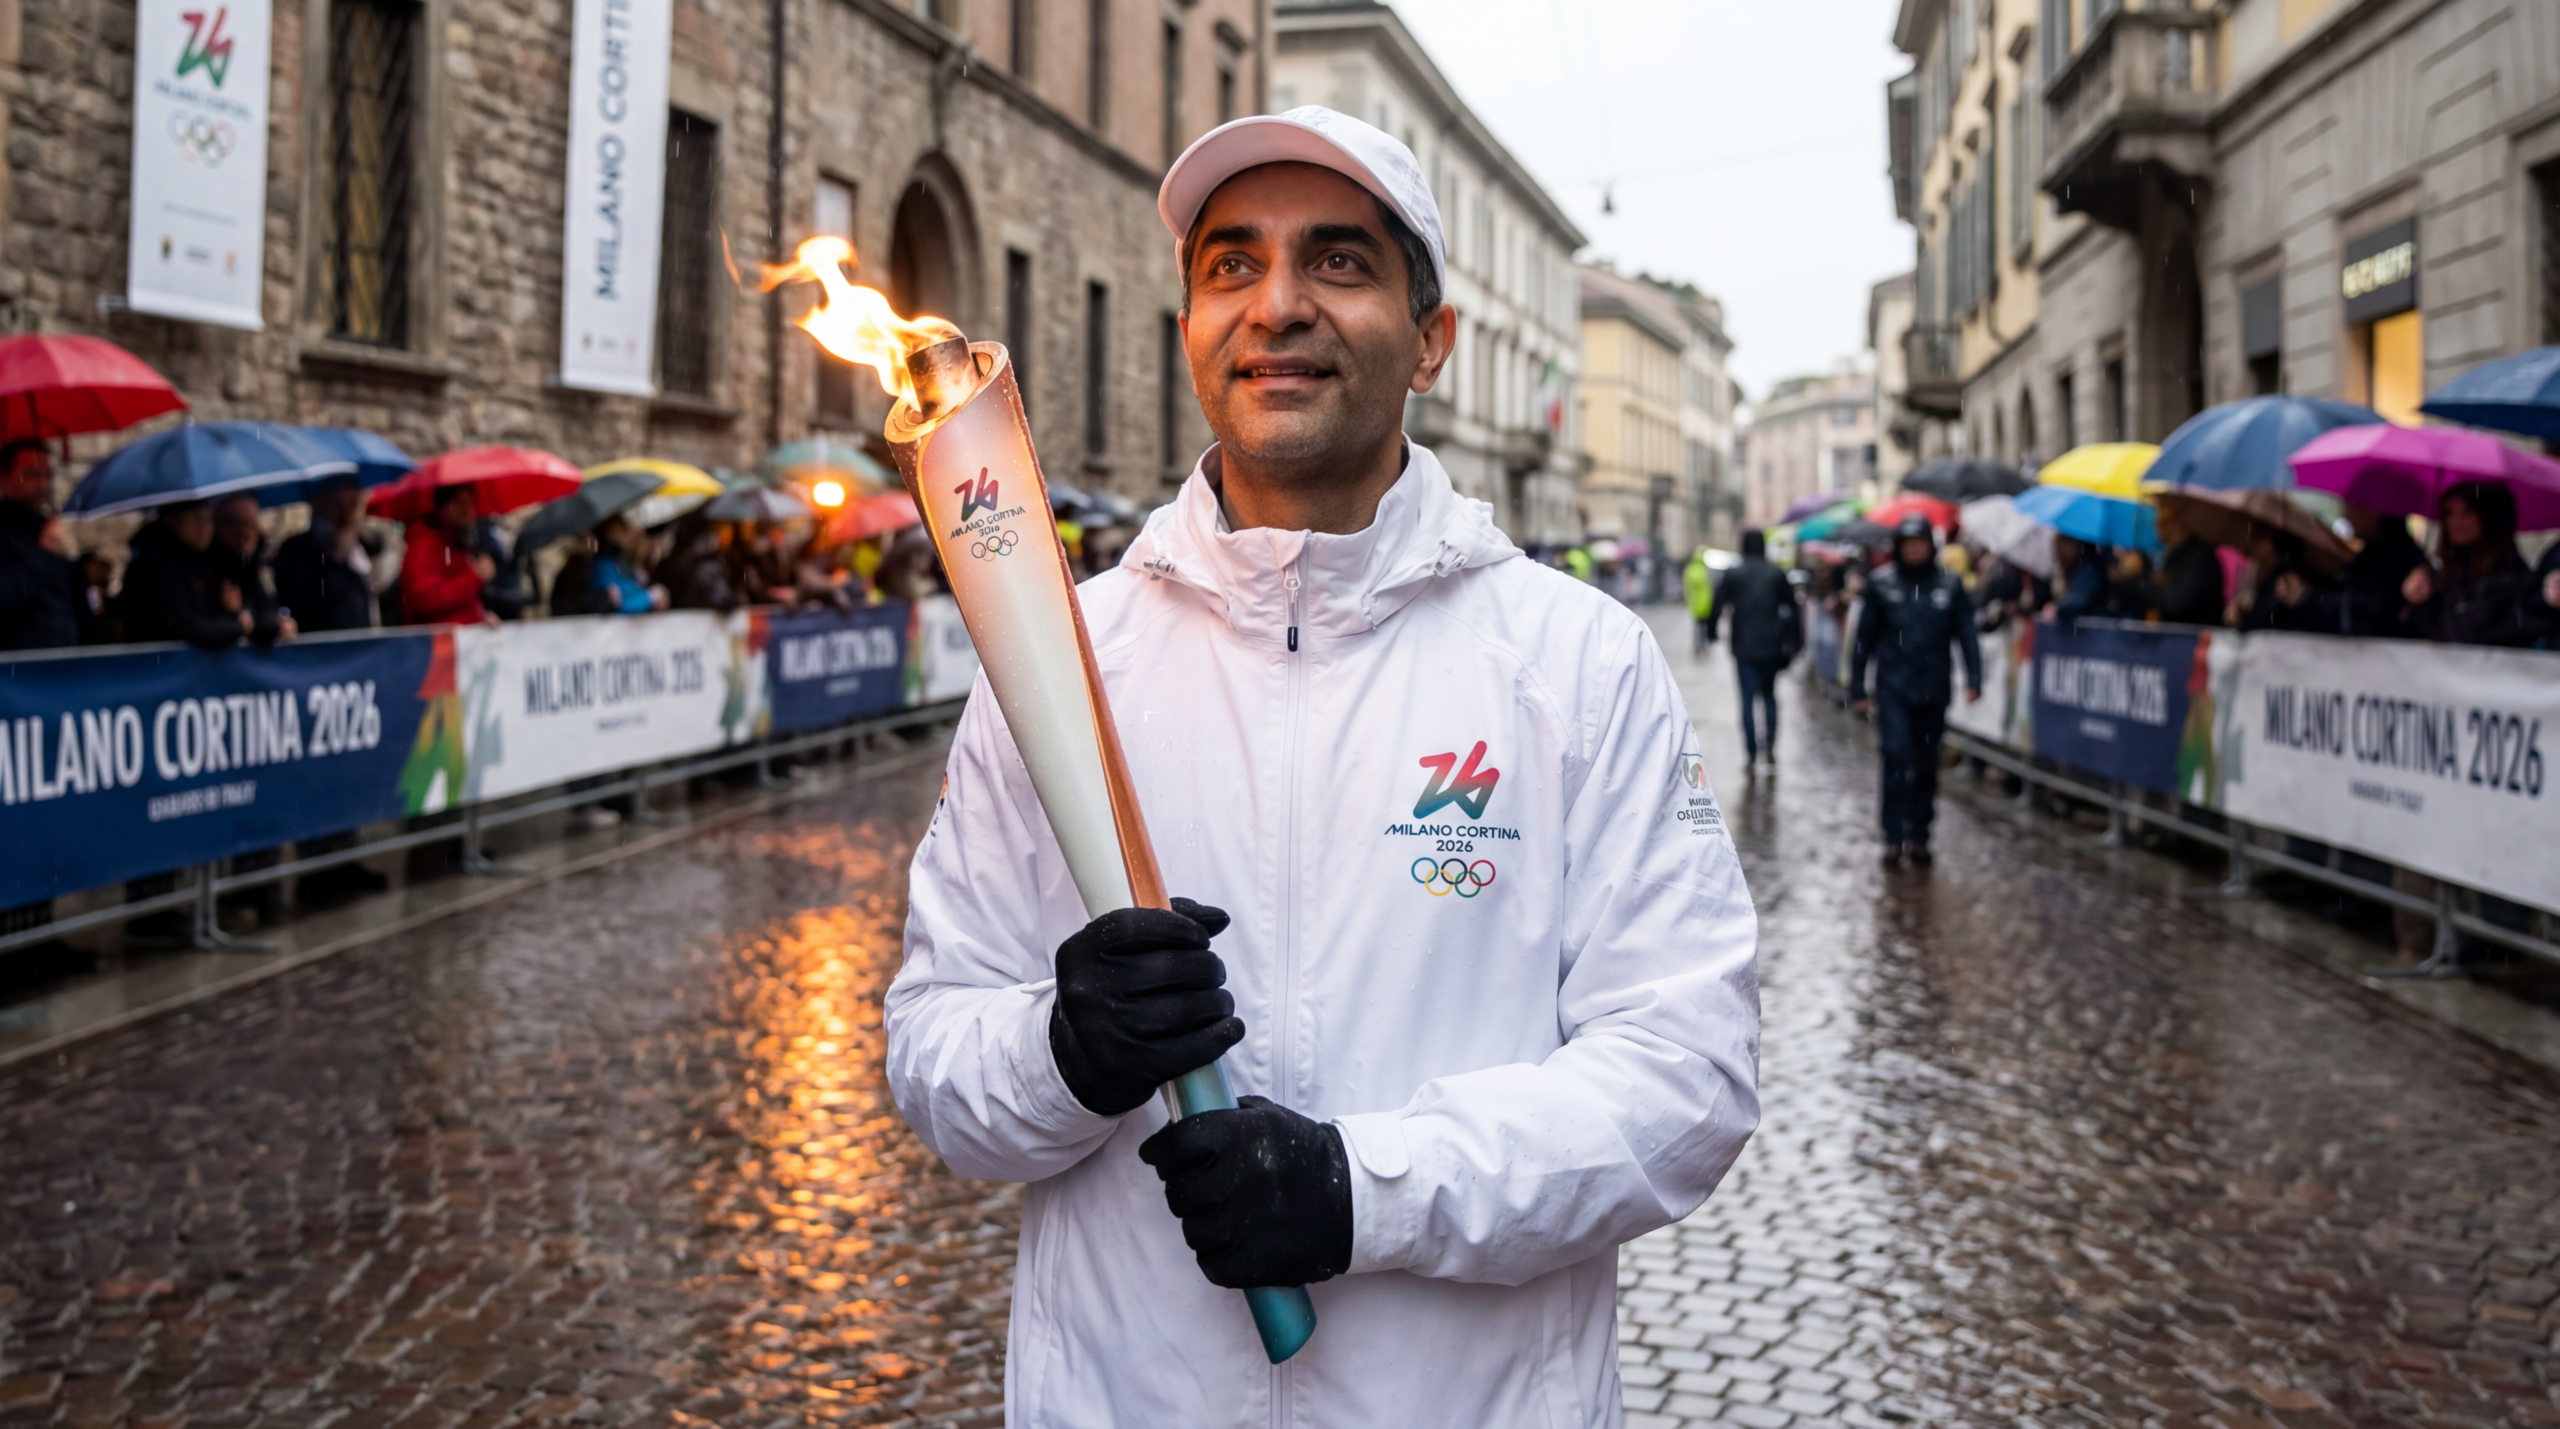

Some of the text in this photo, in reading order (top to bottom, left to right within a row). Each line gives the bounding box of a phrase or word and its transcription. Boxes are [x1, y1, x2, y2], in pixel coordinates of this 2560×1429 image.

[595, 133, 627, 302] MILANO
[153, 689, 303, 782] CORTINA
[307, 679, 381, 758] 2026
[2263, 683, 2346, 759] MILANO
[2351, 692, 2460, 782] CORTINA
[2466, 707, 2544, 799] 2026
[1384, 823, 1521, 841] MILANO CORTINA
[1435, 839, 1475, 853] 2026
